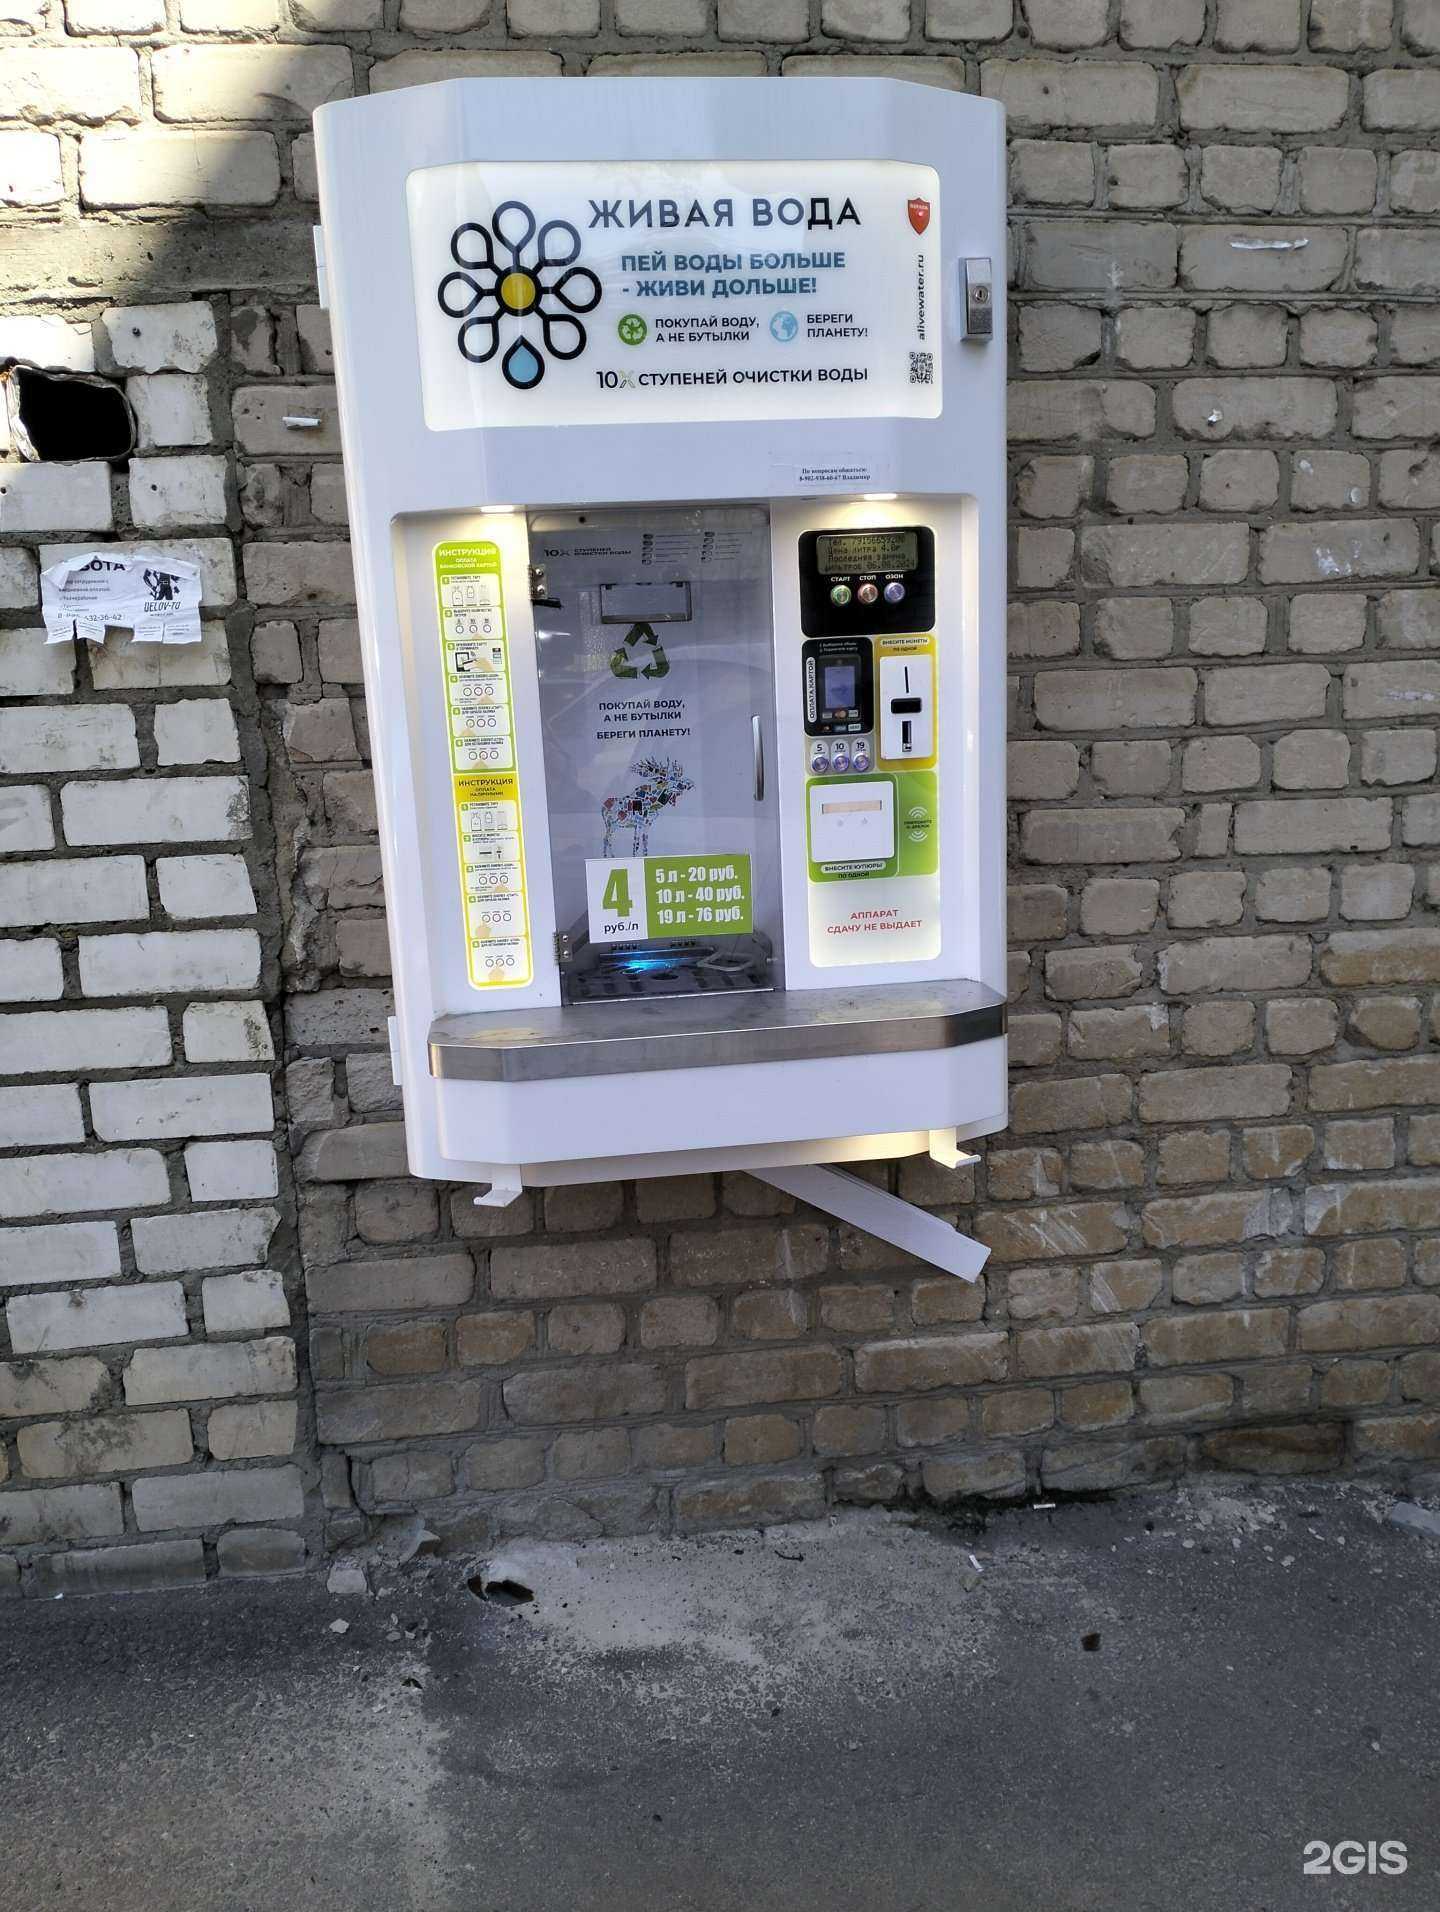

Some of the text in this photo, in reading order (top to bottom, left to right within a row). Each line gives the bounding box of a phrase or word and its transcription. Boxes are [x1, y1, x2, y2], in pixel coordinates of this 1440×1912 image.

[588, 197, 861, 231] ЖИВАЯ ВОДА
[621, 250, 846, 273] ПЕЙ ВОДЫ БОЛЬШЕ
[636, 279, 705, 297] ЖИВИ
[711, 277, 817, 298] ДОЛЬШЕ!
[916, 253, 926, 341] alivewater.ru
[655, 315, 760, 329] ПОКУПАЙ ВОДУ,
[806, 313, 854, 324] БЕРЕГИ
[655, 331, 750, 343] А НЕ БУТЫЛКИ
[807, 327, 868, 338] ПЛАНЕТУ!
[638, 368, 727, 386] СТУПЕНЕЙ
[732, 368, 812, 384] ОЧИСТКИ
[817, 367, 868, 382] ВОДЫ
[598, 699, 685, 711] ПОКУПАЙ ВОДУ,
[603, 711, 682, 722] А НЕ БУТЫЛКИ
[596, 727, 691, 740] БЕРЕГИ ПЛАНЕТУ!
[816, 743, 823, 752] 5
[835, 742, 845, 750] 10
[856, 741, 865, 749] 19
[458, 778, 513, 787] ИНСТРУКЦИЯ
[655, 869, 665, 883] 5
[667, 870, 678, 883] л
[688, 866, 706, 882] 20
[709, 864, 738, 882] руб.
[824, 862, 883, 872] ВНЕСИТЕ КУПЮРЫ
[602, 868, 633, 917] 4
[656, 888, 672, 904] 10
[675, 889, 685, 903] л
[695, 886, 714, 901] 40
[716, 885, 745, 902] руб.
[657, 909, 673, 925] 19
[676, 909, 686, 923] л
[696, 906, 713, 922] 76
[715, 905, 744, 923] руб.
[850, 909, 899, 920] АППАРАТ
[604, 921, 639, 934] руб./л
[827, 920, 922, 935] СДАЧУ НЕ ВЫДАЕТ
